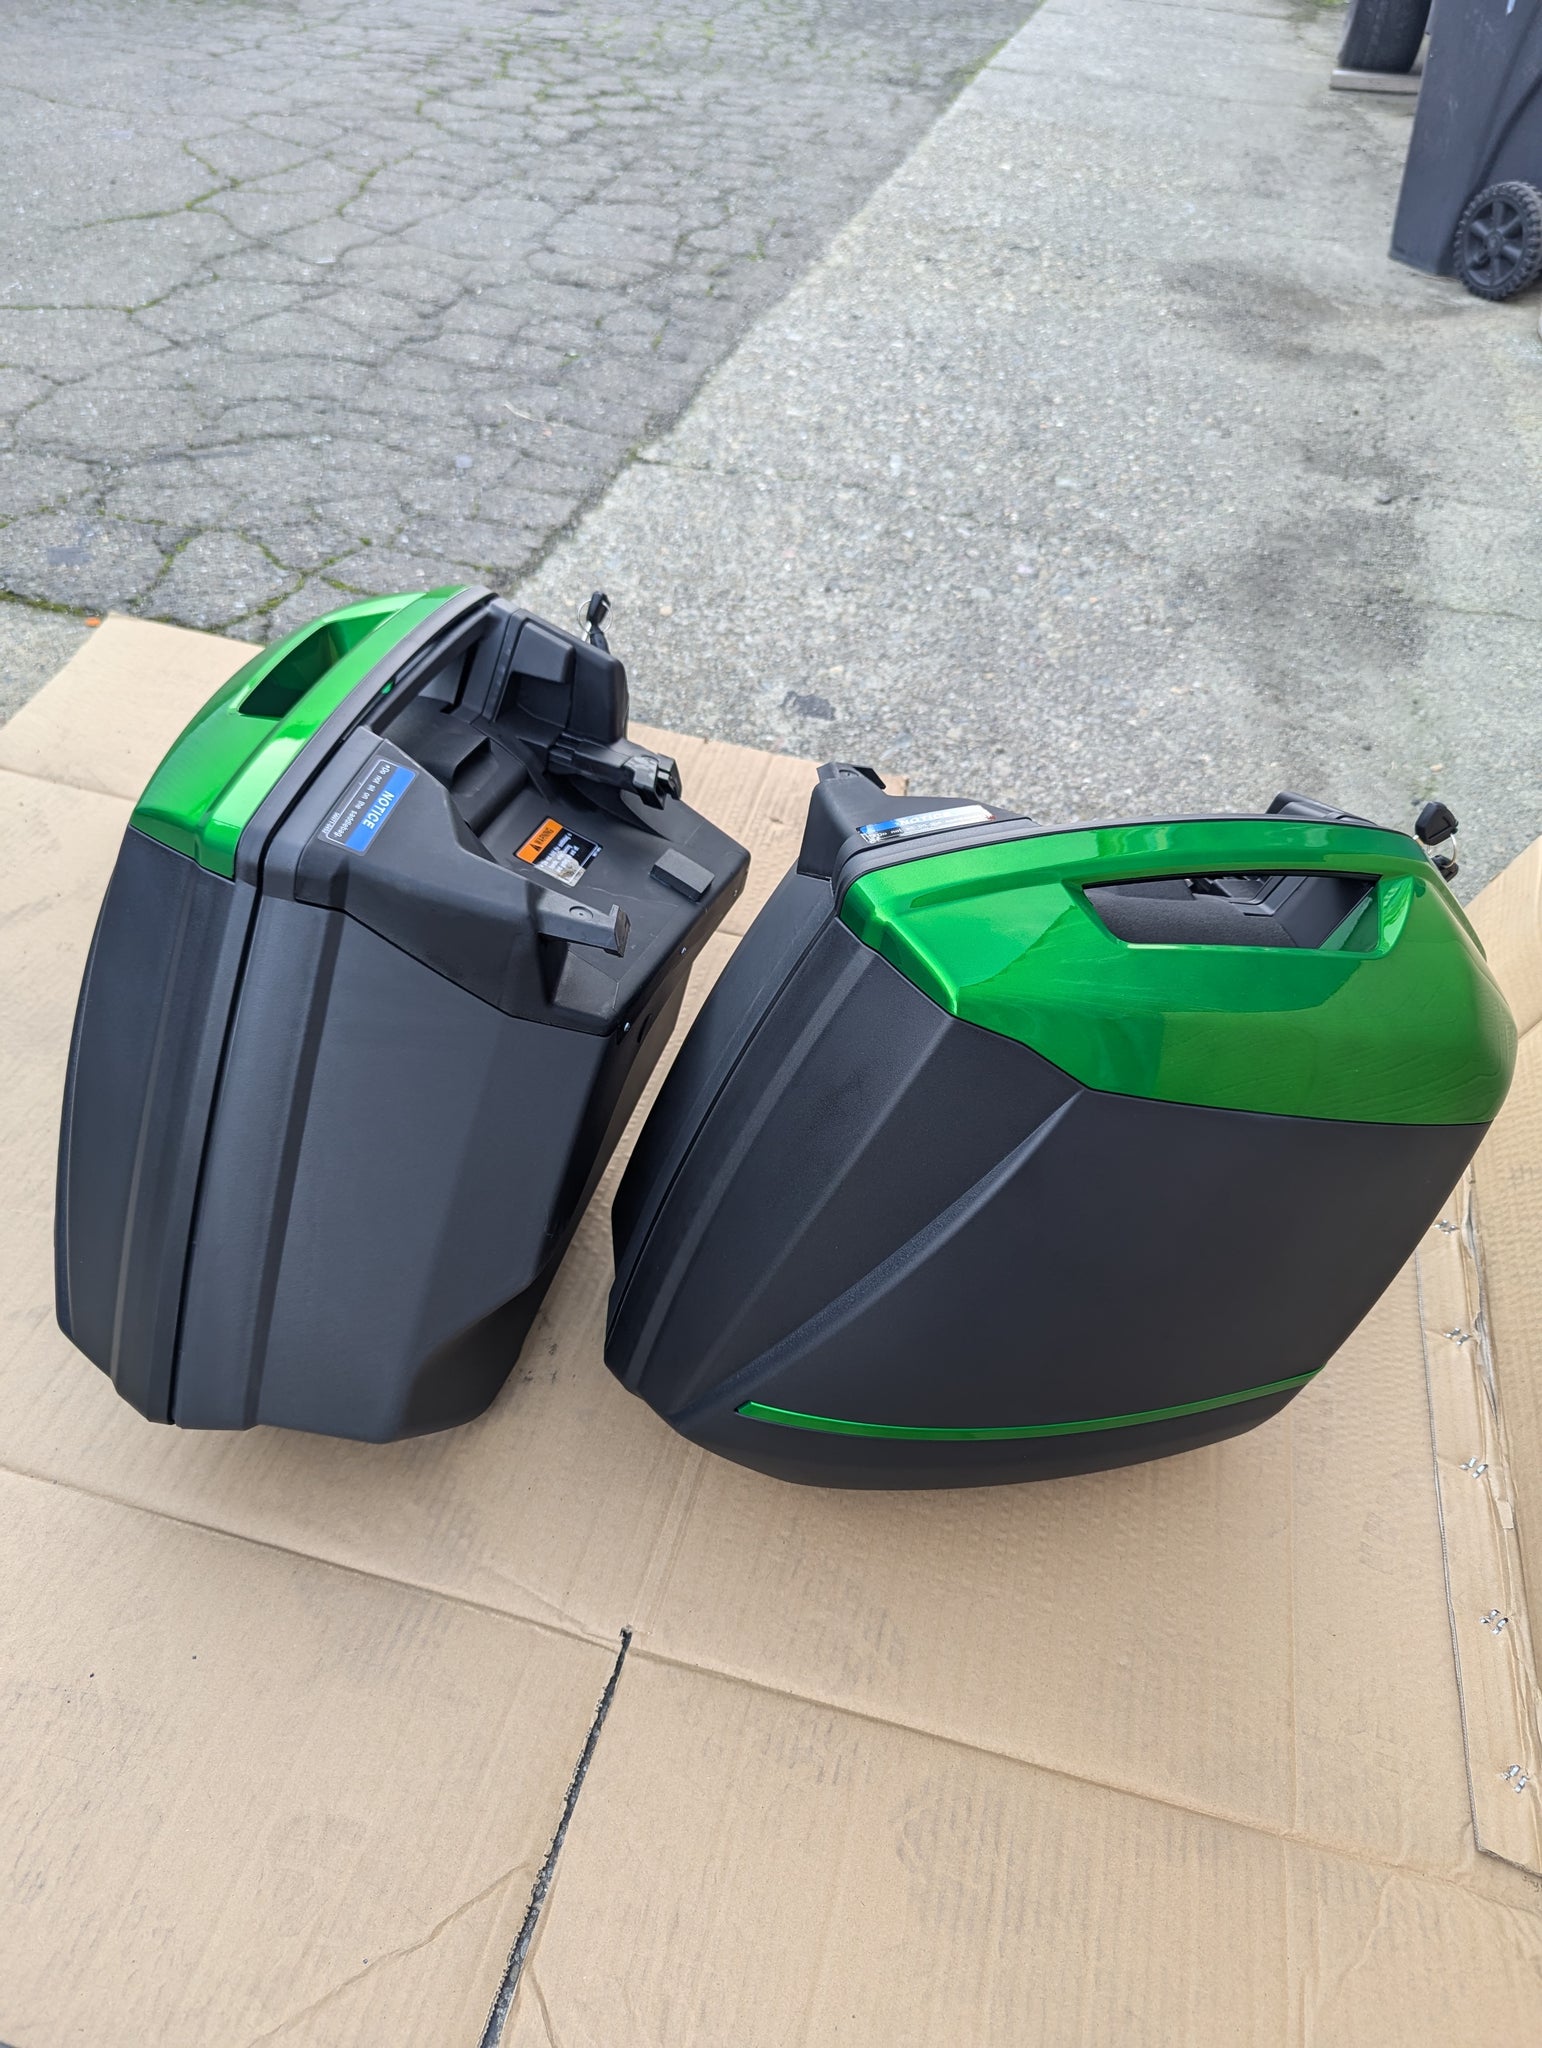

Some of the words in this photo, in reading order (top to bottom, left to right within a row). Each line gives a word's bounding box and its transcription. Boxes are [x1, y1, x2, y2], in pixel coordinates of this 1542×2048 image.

[372, 774, 383, 784] not
[361, 792, 370, 800] on
[354, 800, 366, 810] the
[362, 790, 395, 830] NOTICE
